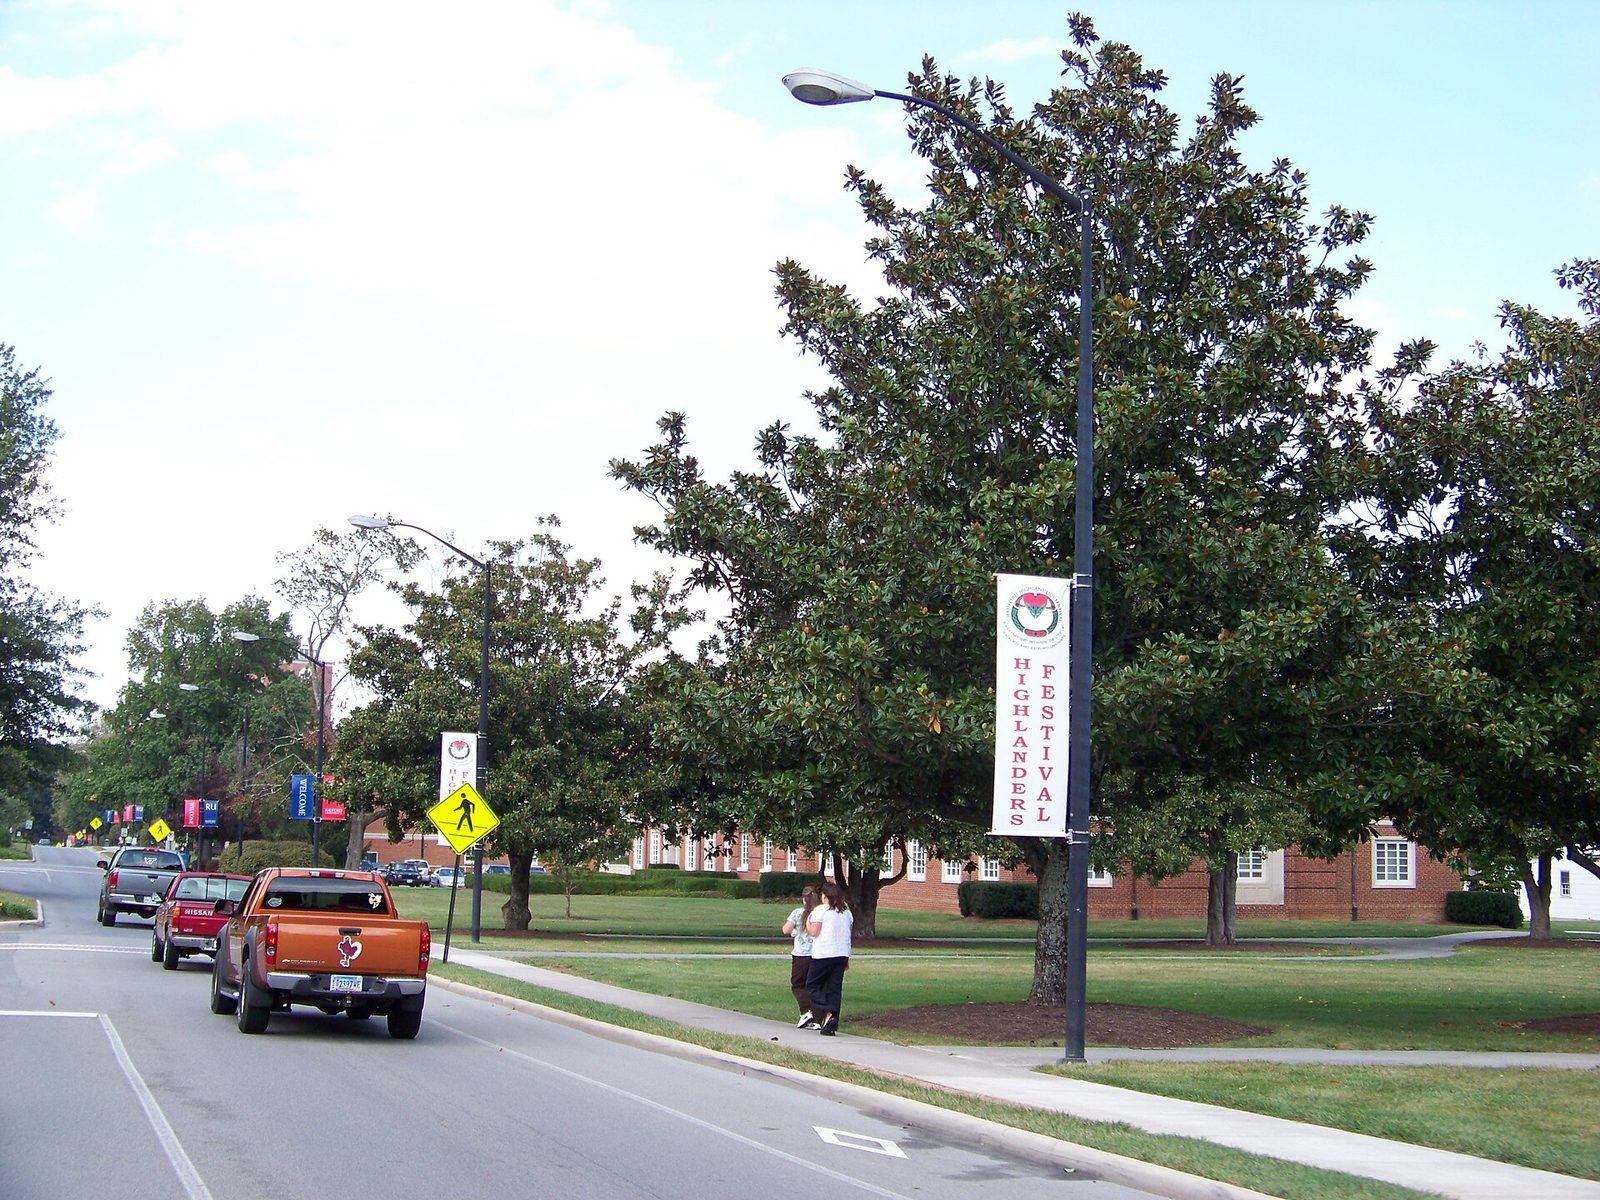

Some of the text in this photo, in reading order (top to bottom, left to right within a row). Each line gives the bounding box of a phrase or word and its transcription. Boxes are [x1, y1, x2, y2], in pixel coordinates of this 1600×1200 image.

[1010, 658, 1031, 826] HIGHLANDERS
[1036, 664, 1056, 822] FESTIVAL
[205, 802, 217, 811] RU
[298, 778, 308, 817] WELCOME
